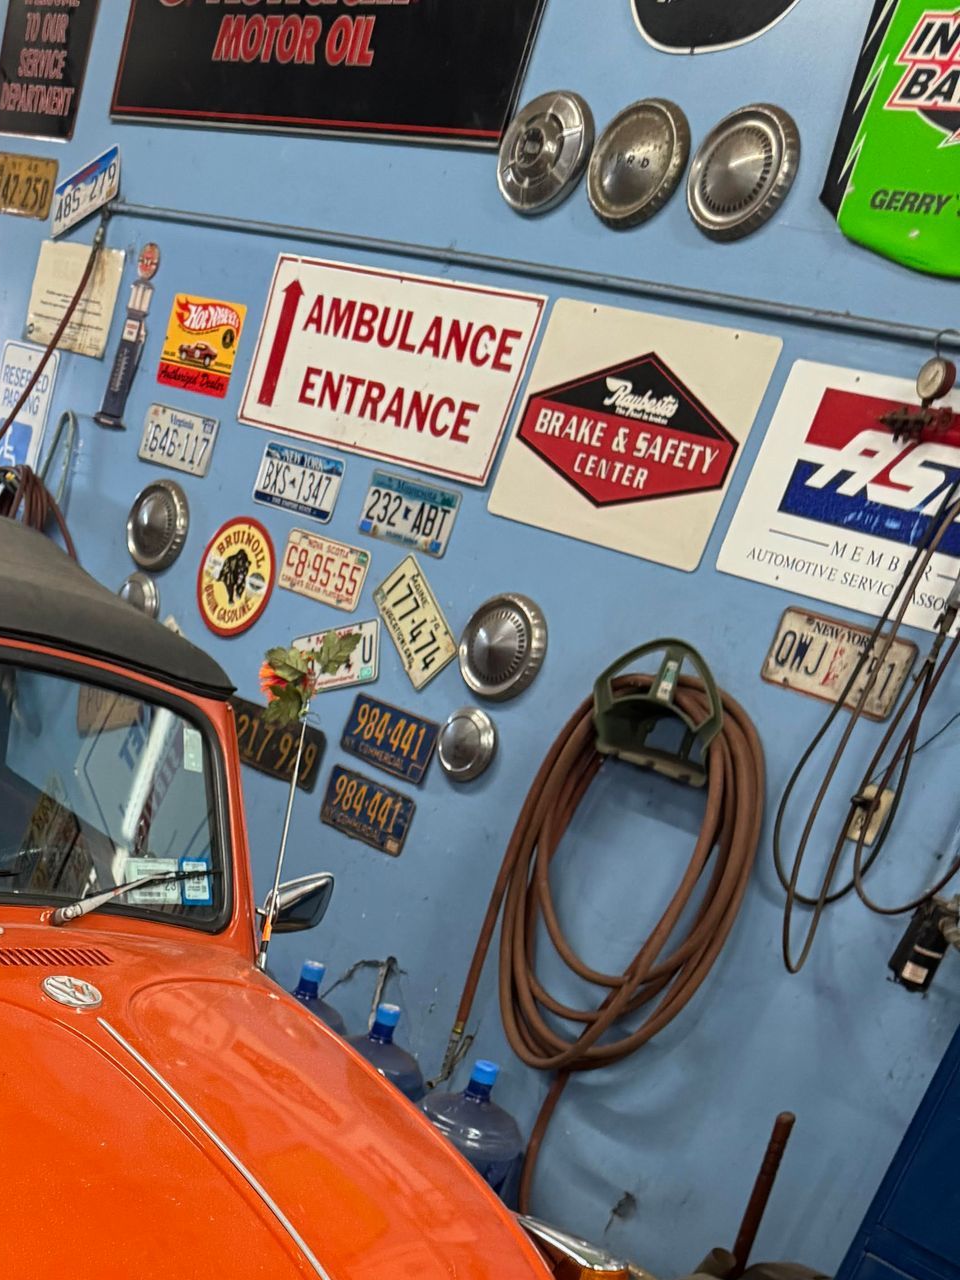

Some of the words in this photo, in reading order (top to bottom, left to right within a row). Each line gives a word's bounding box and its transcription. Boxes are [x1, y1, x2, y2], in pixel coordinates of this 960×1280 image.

[25, 12, 40, 42] TO
[42, 14, 69, 43] OUR
[211, 14, 322, 65] MOTOR
[325, 15, 377, 67] OIL
[18, 48, 67, 79] SERVICE
[0, 83, 74, 117] DEPARTMENT
[302, 294, 523, 373] AMBULANCE
[298, 366, 480, 444] ENTRANCE
[603, 376, 679, 418] Raybestos
[534, 408, 608, 447] BRAKE
[611, 426, 630, 453] &
[633, 432, 719, 474] SAFETY
[573, 452, 649, 490] CENTER
[366, 489, 402, 527] 232
[411, 503, 450, 541] ABT
[217, 530, 265, 569] BRUINOIL
[746, 546, 838, 582] AUTOMOTIVE
[813, 621, 841, 640] NEW
